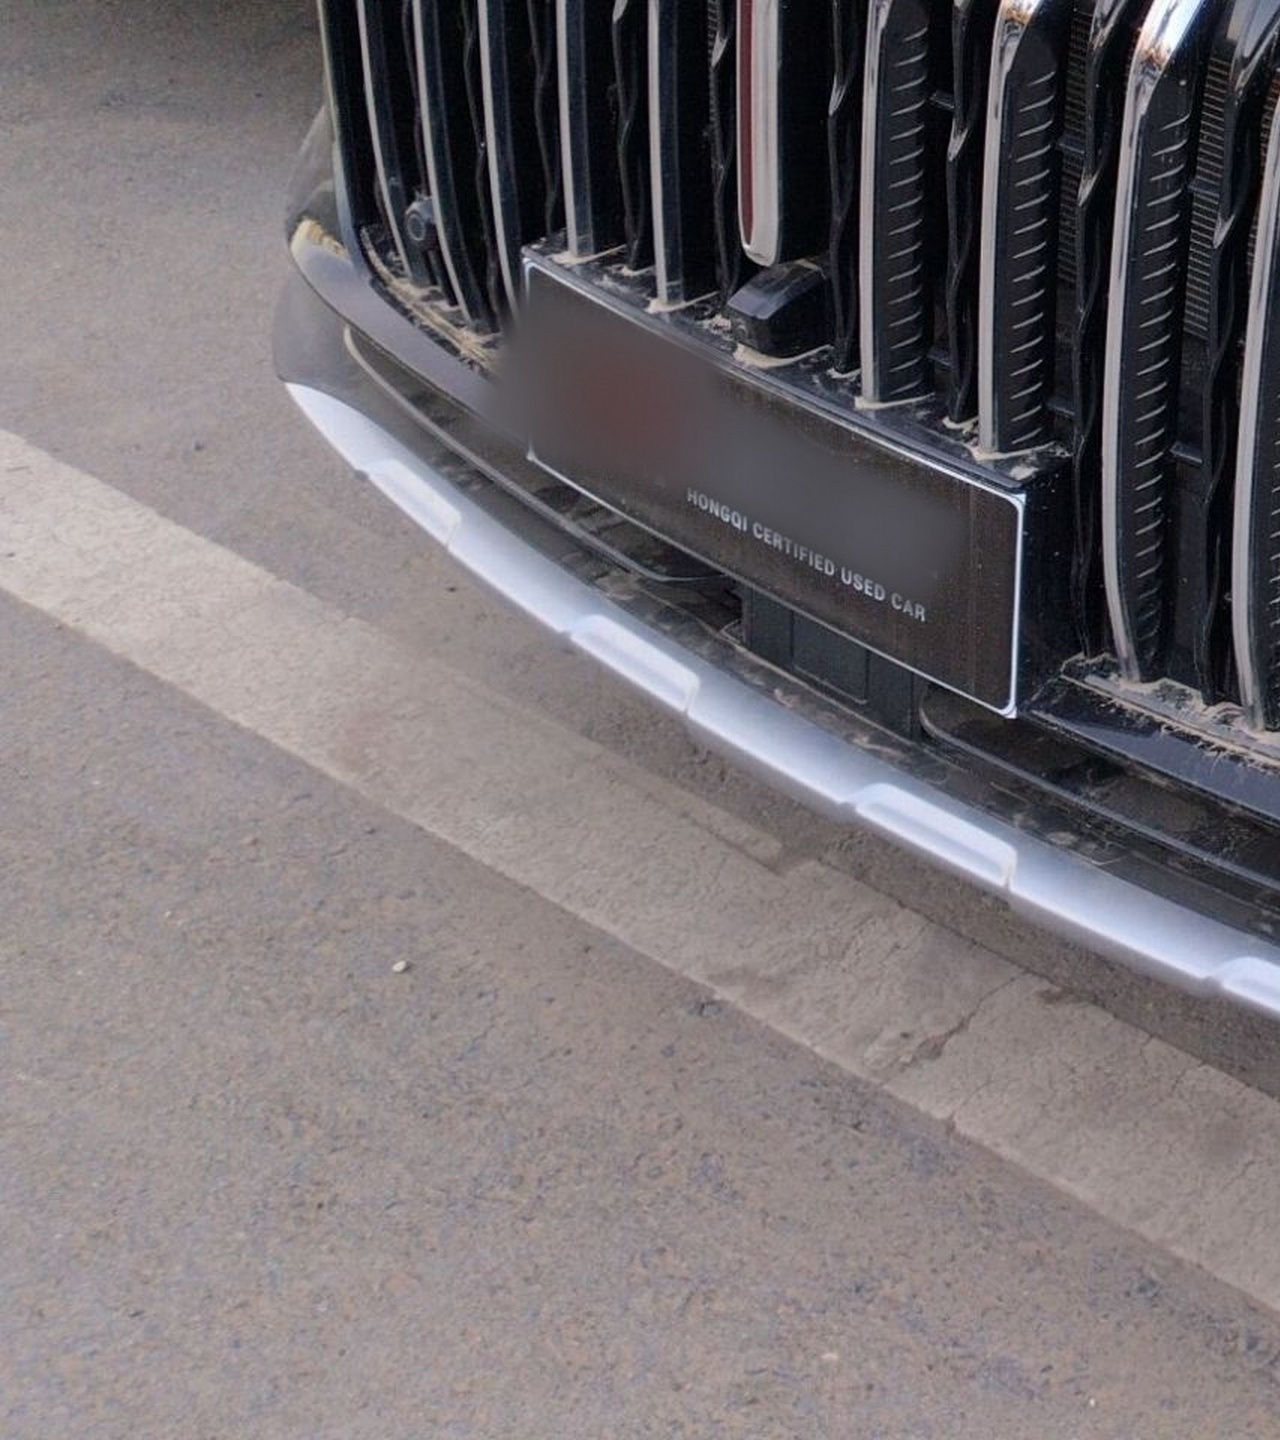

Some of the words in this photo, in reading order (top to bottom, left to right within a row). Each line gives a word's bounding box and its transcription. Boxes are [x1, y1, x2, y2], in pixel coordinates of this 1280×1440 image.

[686, 487, 748, 532] HONGQI
[752, 522, 835, 576] CERTIFIED
[840, 567, 886, 601] USED
[891, 592, 927, 622] CAR
